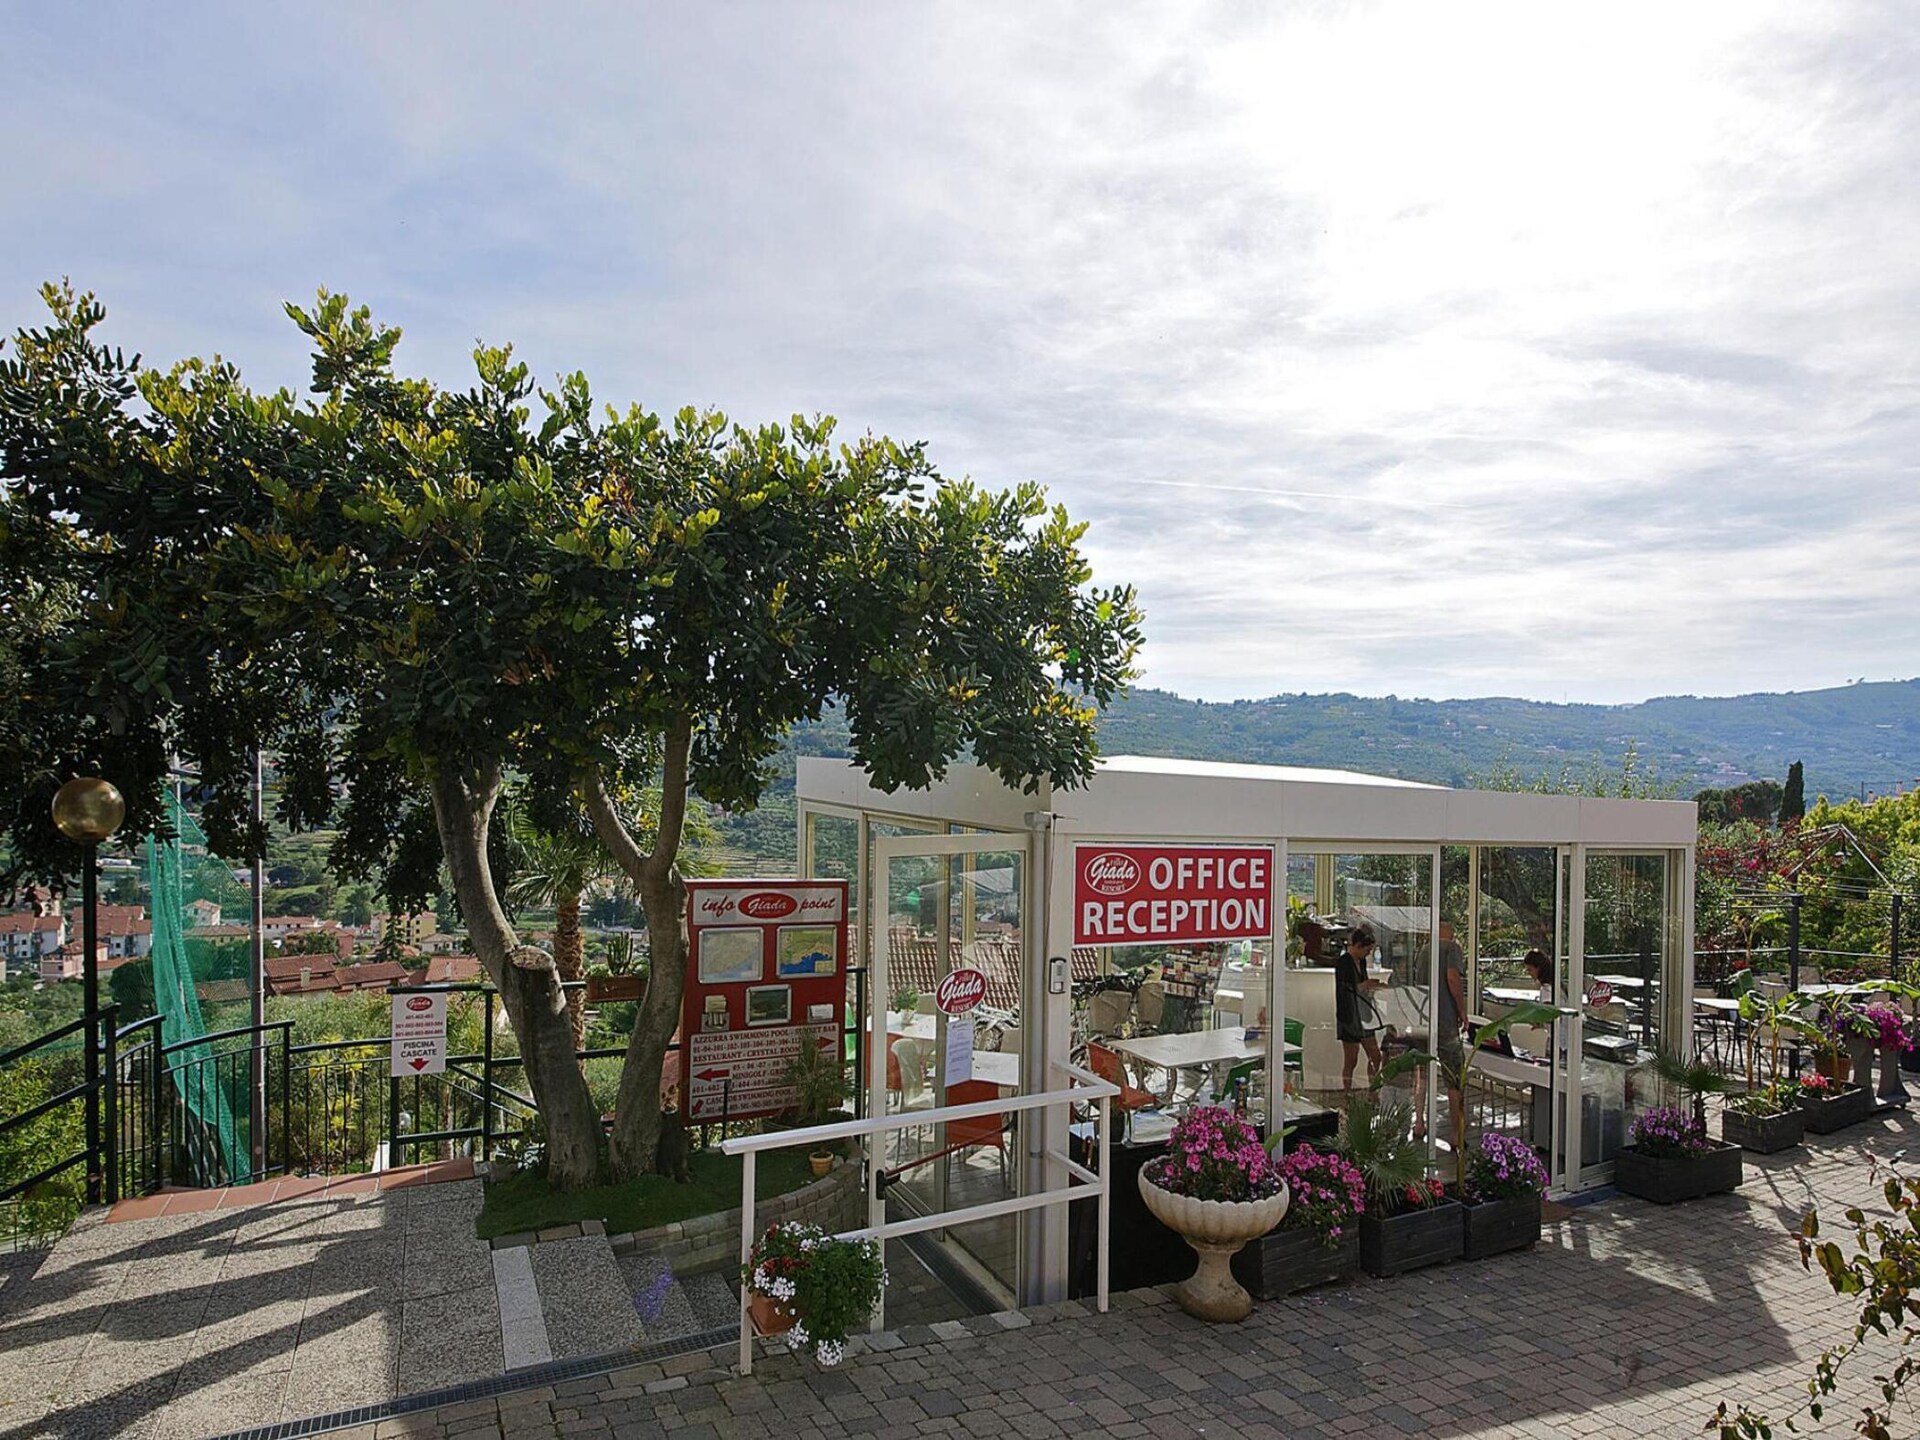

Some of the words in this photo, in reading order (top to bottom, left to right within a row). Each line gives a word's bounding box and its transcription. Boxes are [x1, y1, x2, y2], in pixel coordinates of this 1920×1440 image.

[1091, 857, 1135, 887] Giada
[1149, 857, 1265, 890] OFFICE
[702, 896, 735, 917] info
[748, 897, 786, 914] Giada
[799, 896, 836, 912] point
[1083, 898, 1265, 936] RECEPTION
[941, 972, 983, 1010] Giada
[693, 1034, 728, 1044] AZZURRA
[729, 1030, 769, 1041] SWIMMING
[771, 1028, 788, 1038] POOL
[823, 1024, 836, 1032] BAR
[400, 1049, 437, 1058] CASCATE
[403, 1040, 435, 1049] PISCINA
[693, 1051, 742, 1063] RESTAURANT
[747, 1047, 778, 1057] CRYSTAL
[706, 1093, 738, 1106] CASCDE
[738, 1089, 774, 1101] SWIMMING
[775, 1088, 791, 1097] POOL
